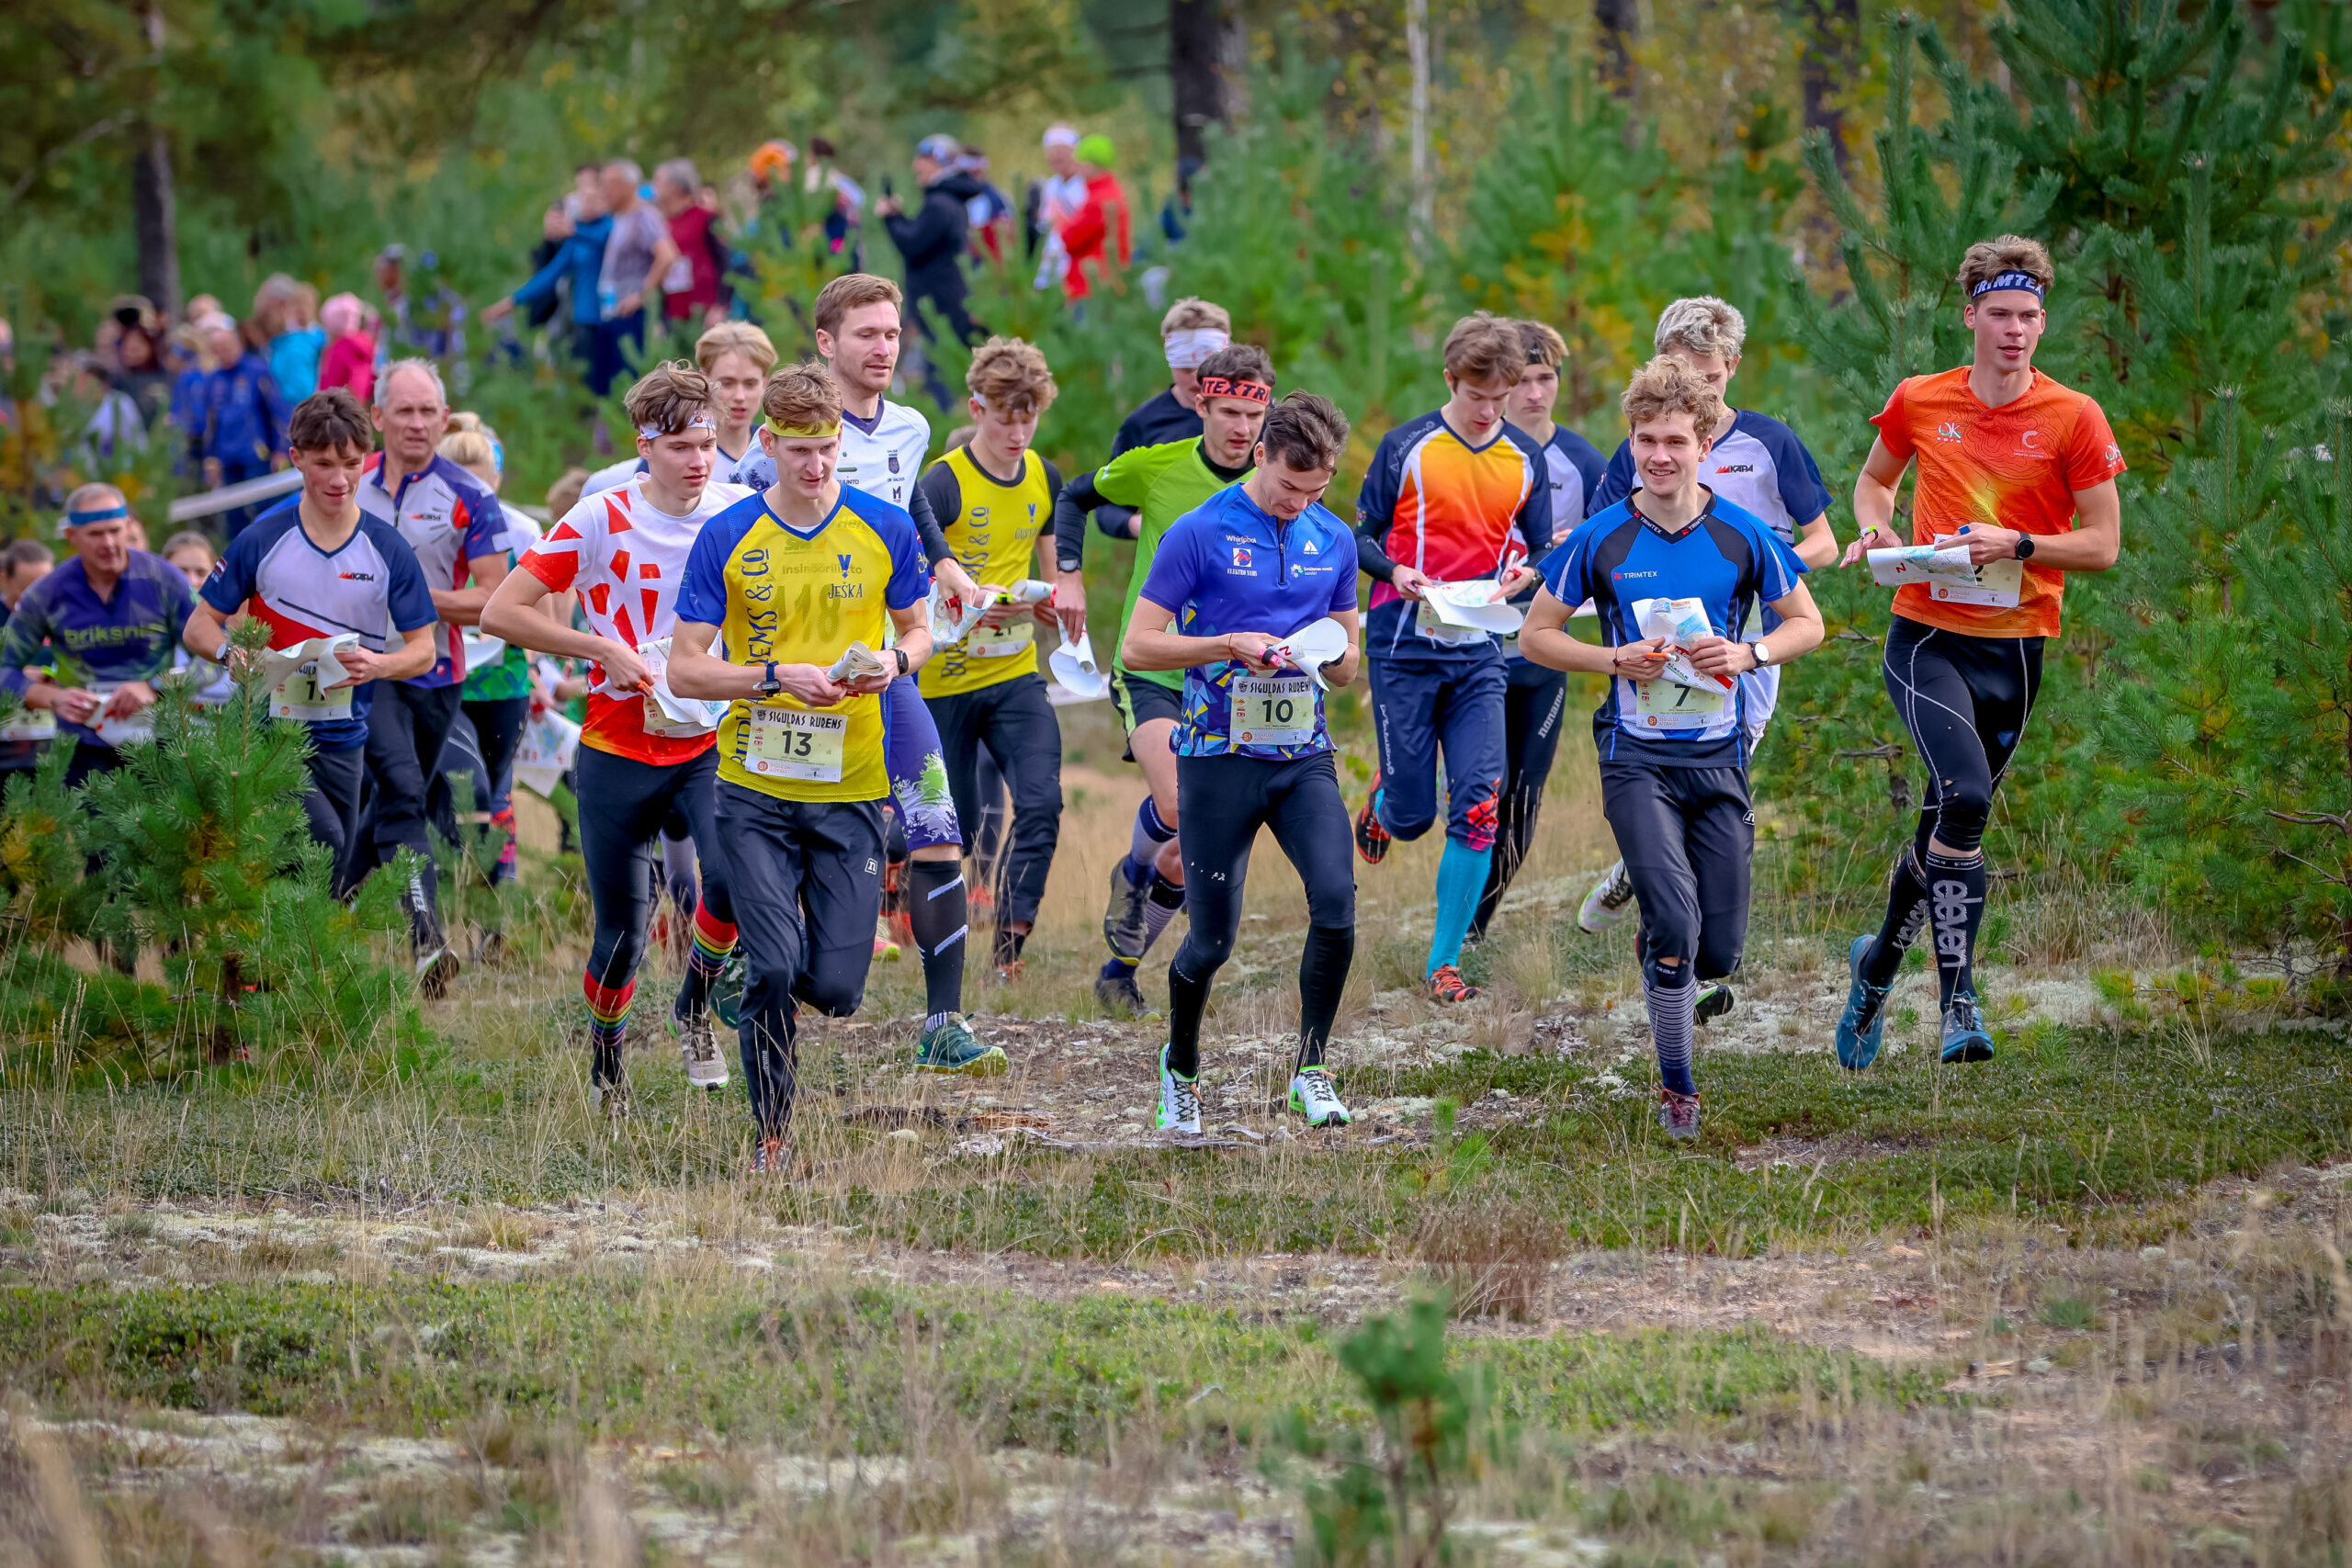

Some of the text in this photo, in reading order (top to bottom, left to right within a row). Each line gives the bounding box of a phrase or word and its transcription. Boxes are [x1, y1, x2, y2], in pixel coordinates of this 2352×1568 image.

[1640, 516, 1663, 535] TRIMTEX
[1623, 570, 1657, 580] TRIMTEX
[744, 584, 774, 602] &
[1250, 682, 1285, 694] SIGULDAS
[1675, 683, 1690, 706] 7
[768, 711, 842, 730] SIGULDAS RUDENS
[1261, 699, 1294, 723] 10
[782, 730, 812, 756] 13
[1932, 879, 1983, 968] eleven
